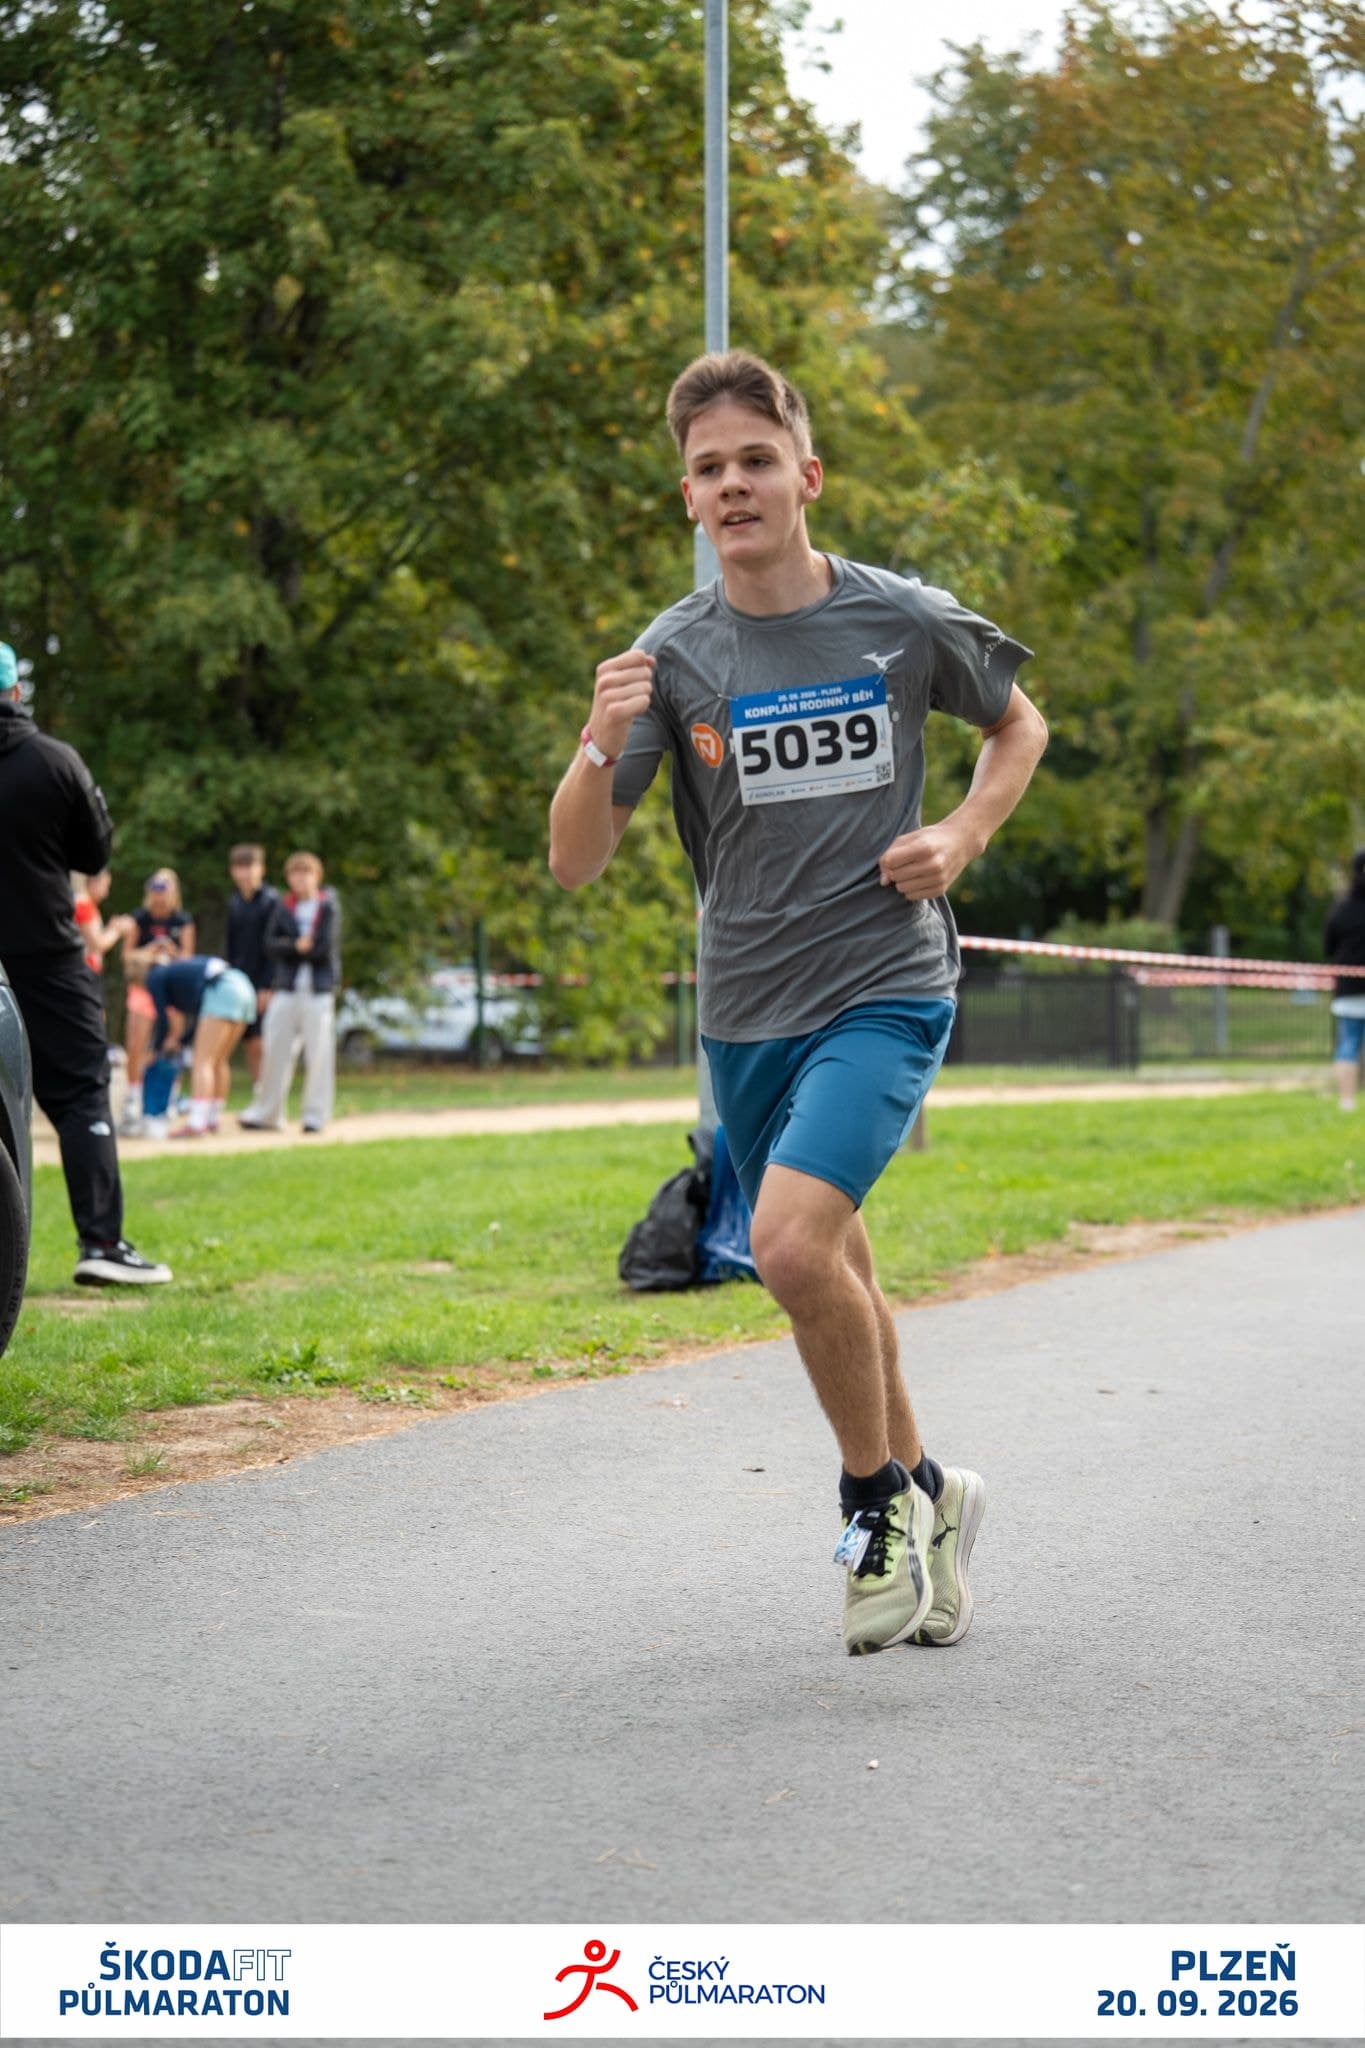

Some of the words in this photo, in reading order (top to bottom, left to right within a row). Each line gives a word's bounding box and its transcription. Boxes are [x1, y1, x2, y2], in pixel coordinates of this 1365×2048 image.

[744, 703, 798, 720] KONPLAN
[799, 693, 850, 712] RODINNÝ
[852, 689, 874, 704] BĚH
[741, 713, 878, 776] 5039
